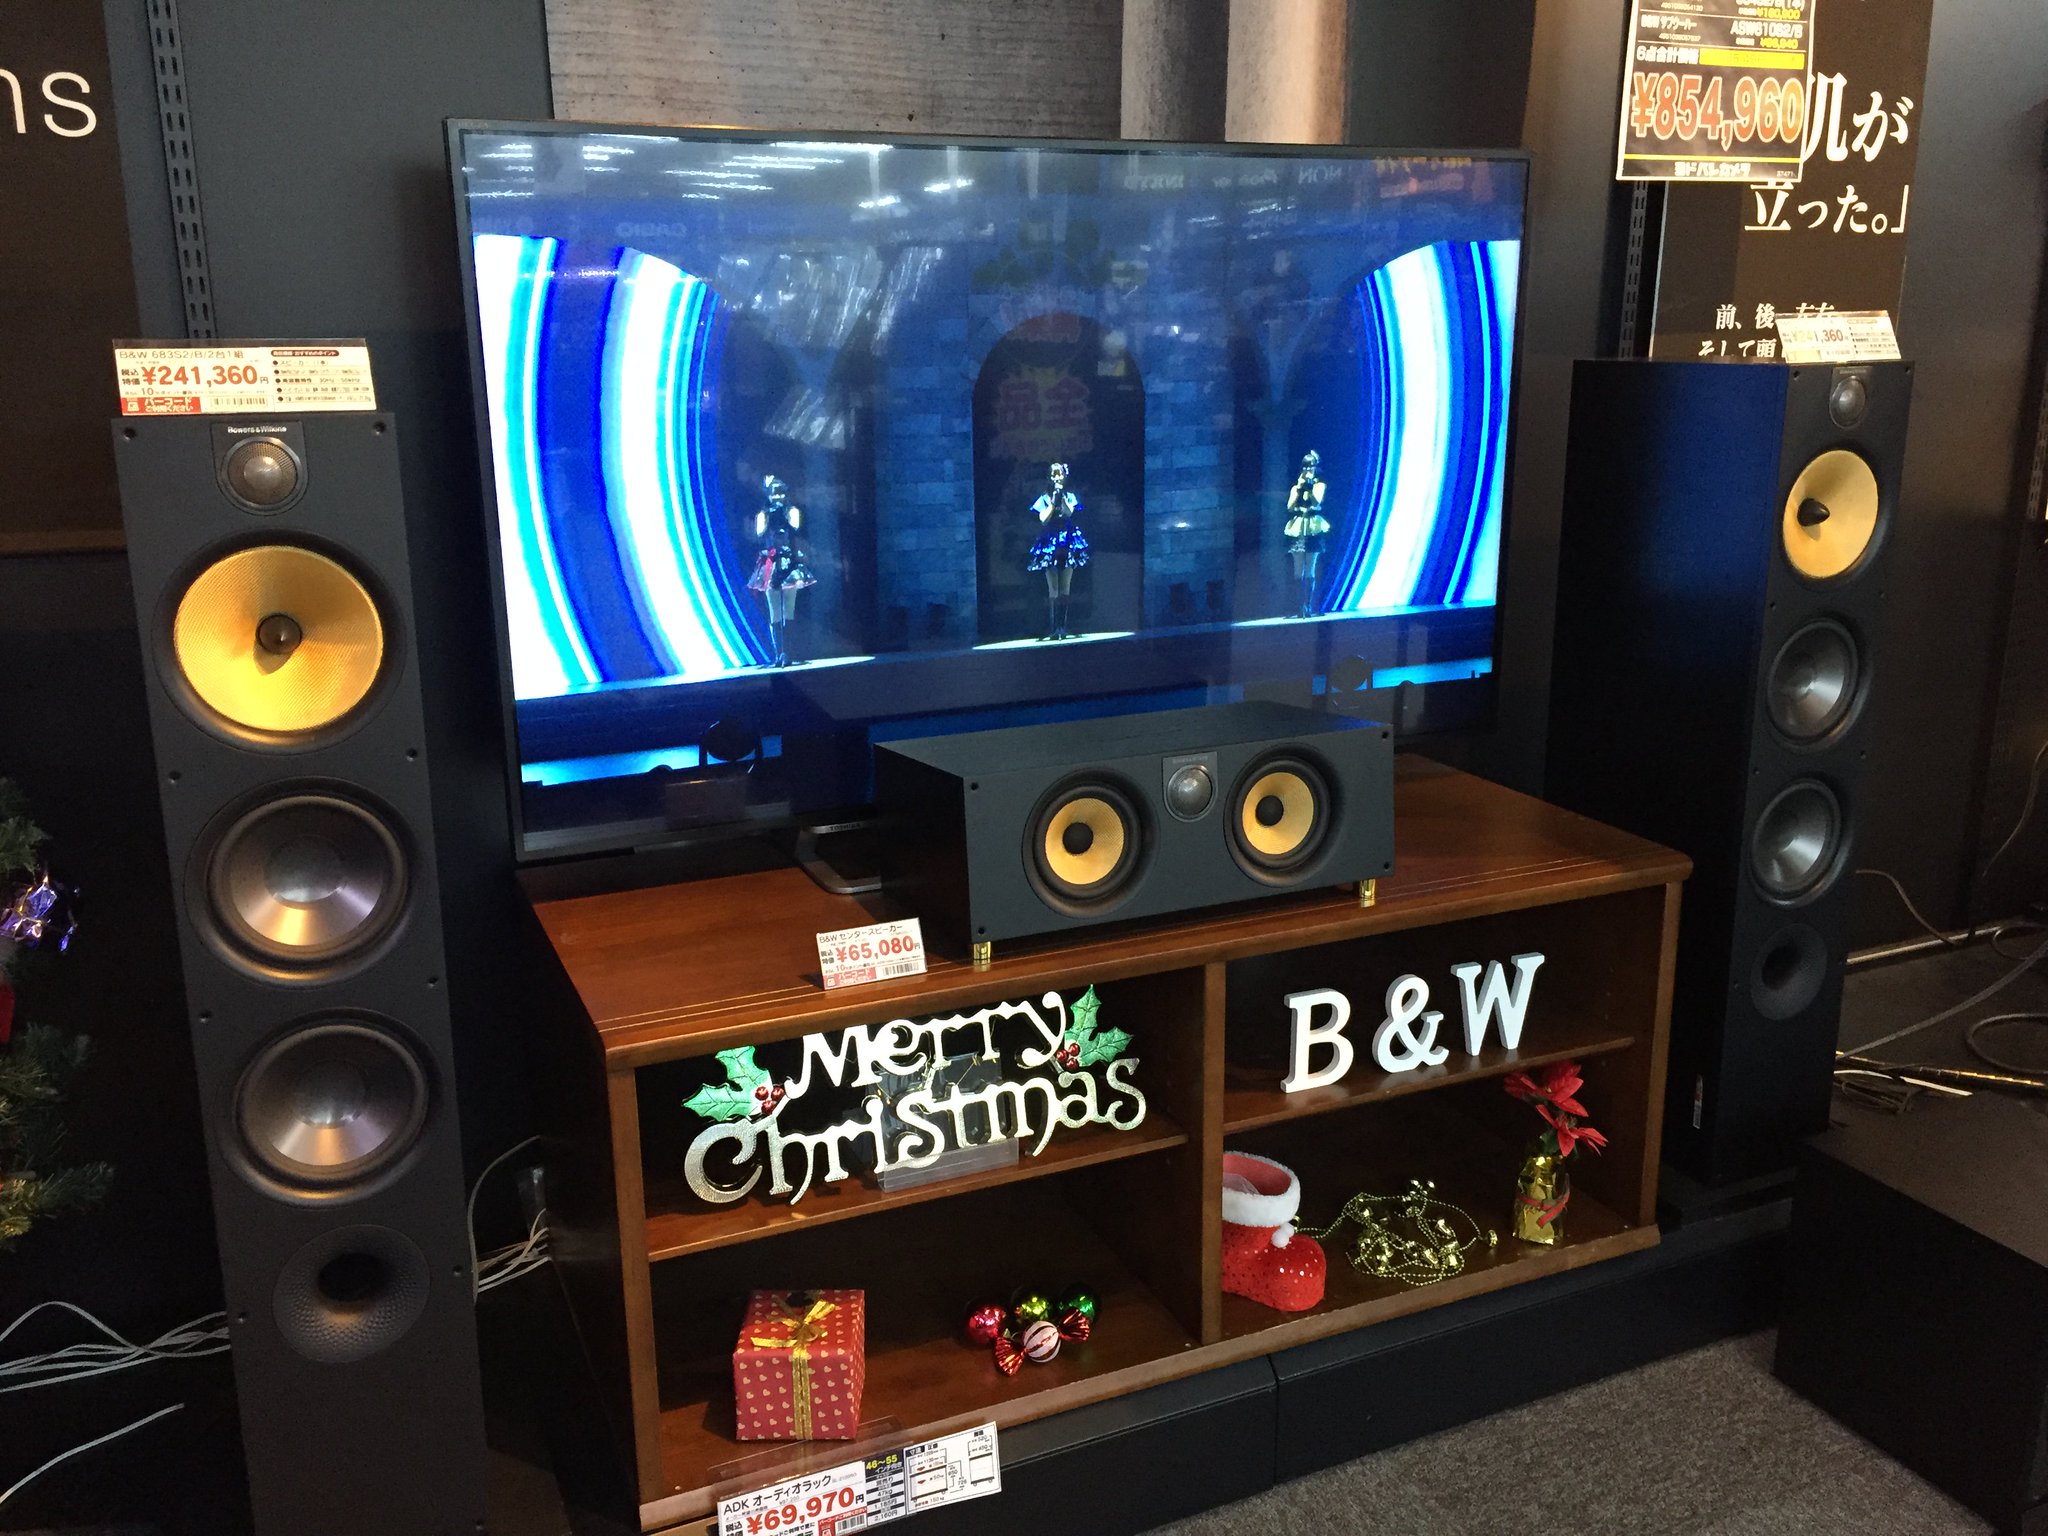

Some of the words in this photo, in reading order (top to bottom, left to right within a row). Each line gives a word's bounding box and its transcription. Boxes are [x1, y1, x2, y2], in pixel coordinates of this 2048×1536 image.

[1631, 72, 1804, 152] ¥854,960
[119, 350, 147, 359] B&W
[784, 991, 1067, 1099] Merry
[684, 1057, 1147, 1206] Christmas
[723, 1499, 750, 1516] ADK
[753, 1474, 832, 1507] オーディオラック
